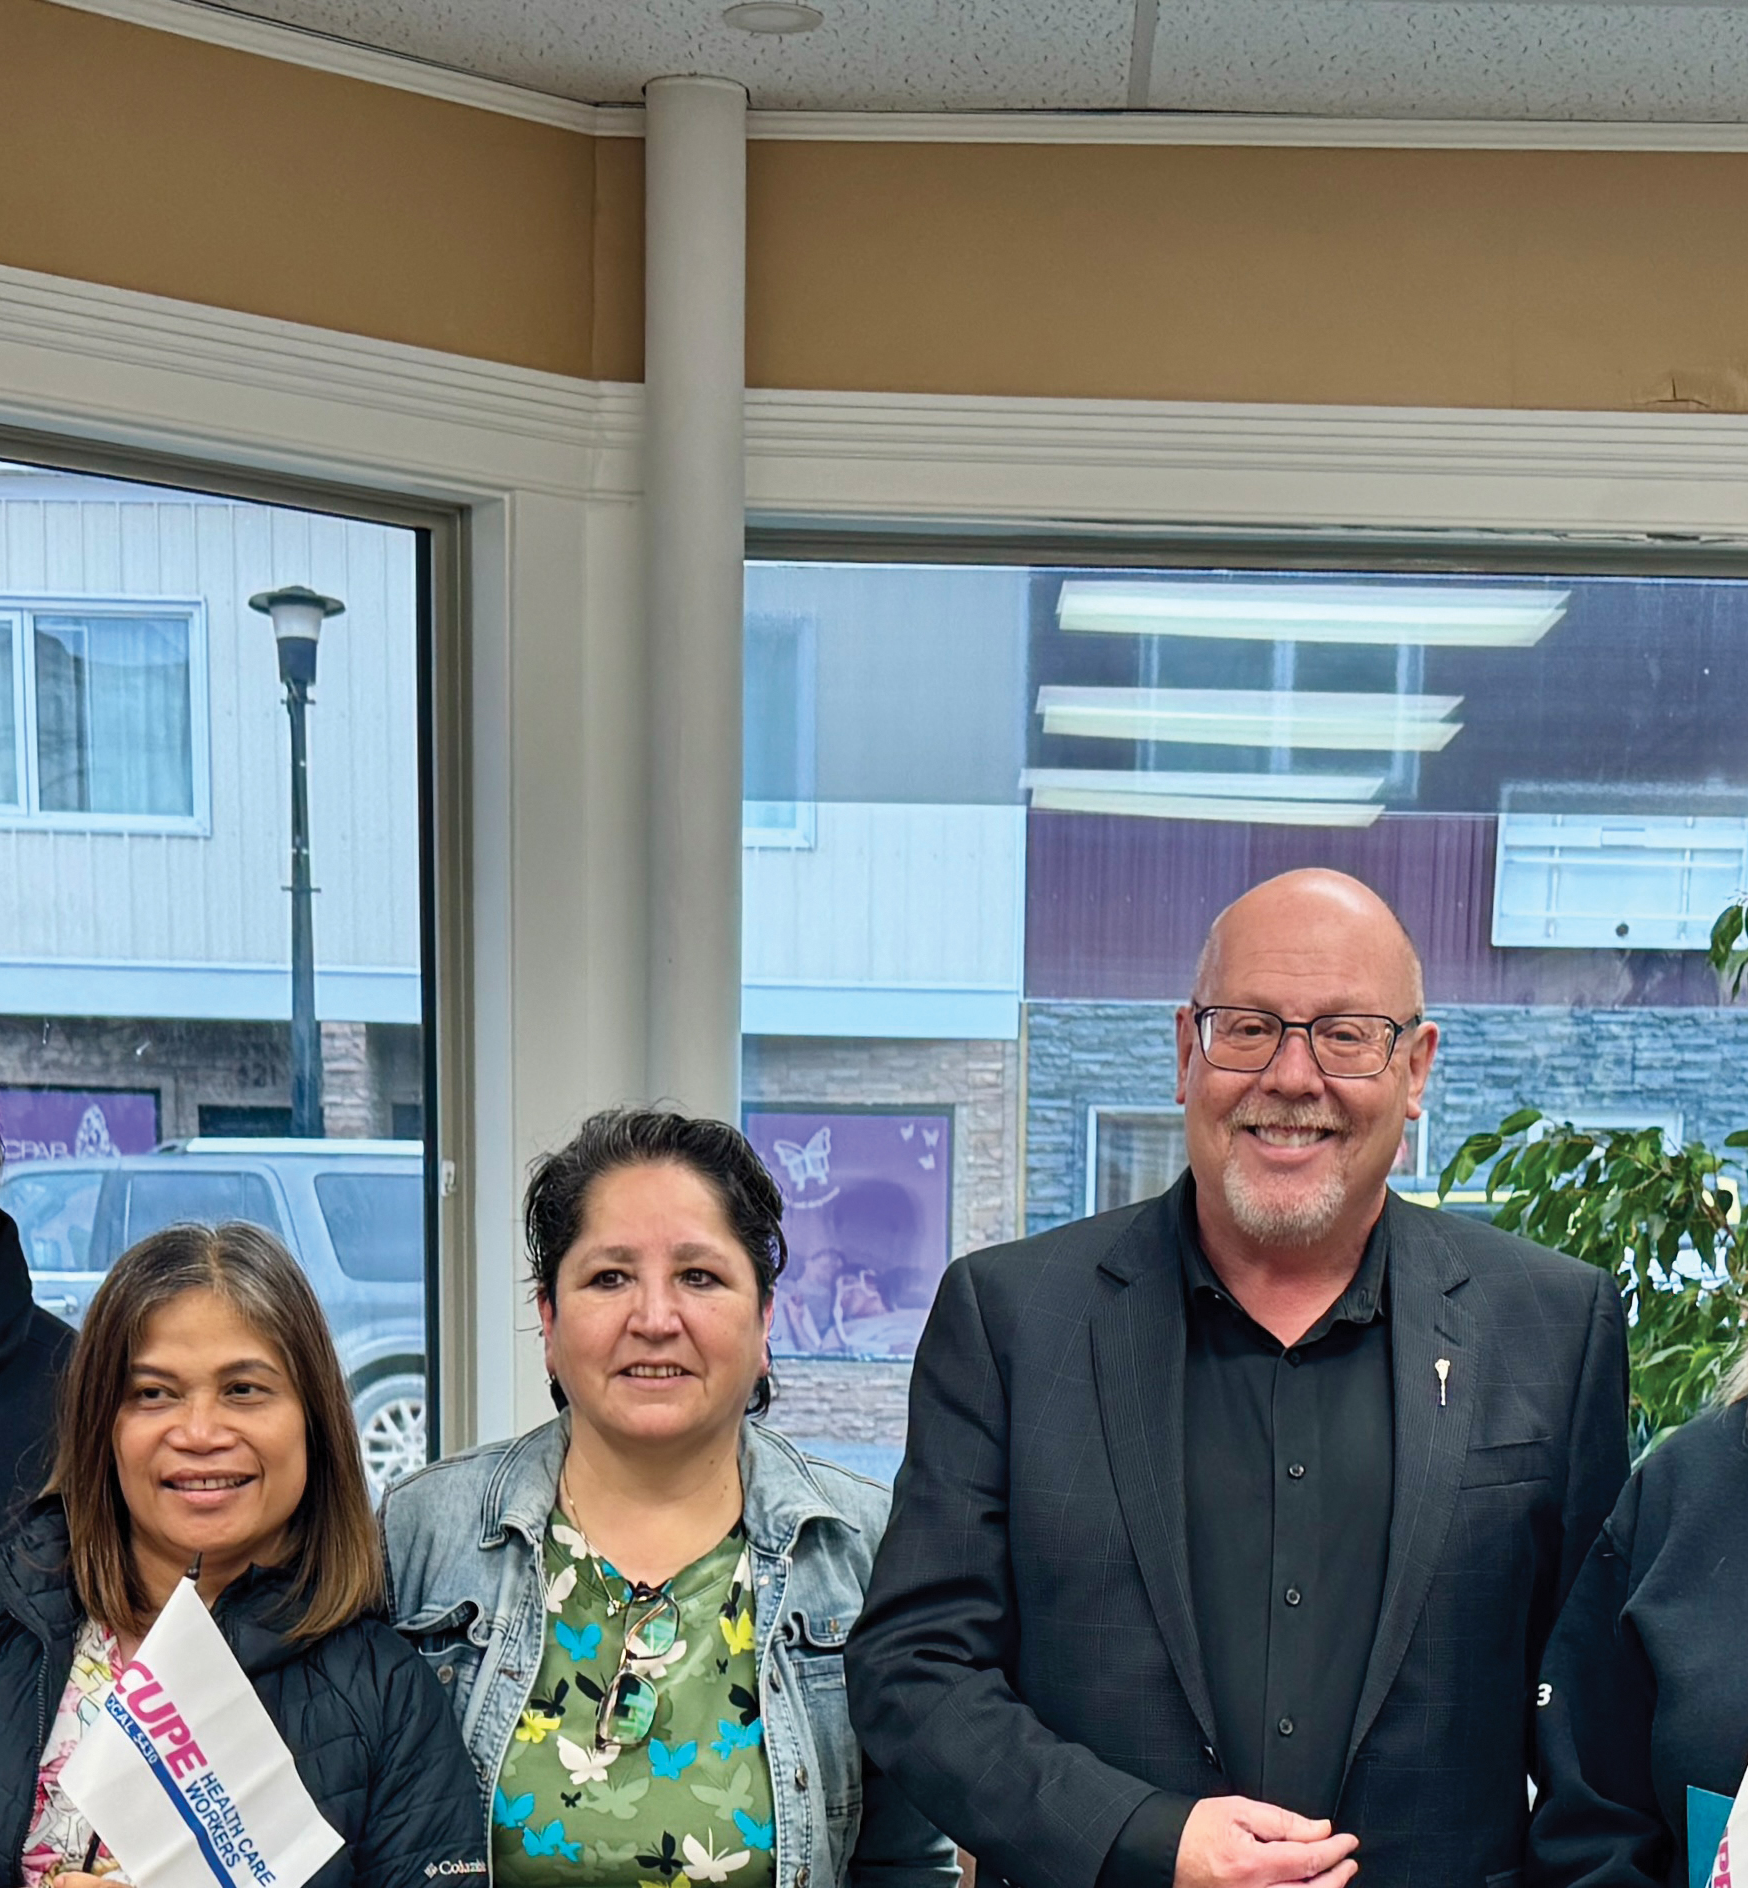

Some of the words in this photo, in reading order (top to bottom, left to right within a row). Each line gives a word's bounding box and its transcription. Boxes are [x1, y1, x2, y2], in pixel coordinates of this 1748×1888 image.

[115, 1660, 208, 1780] CUPE
[185, 1781, 241, 1869] WORKERS
[200, 1771, 246, 1839] HEALTH
[238, 1837, 276, 1888] CARE
